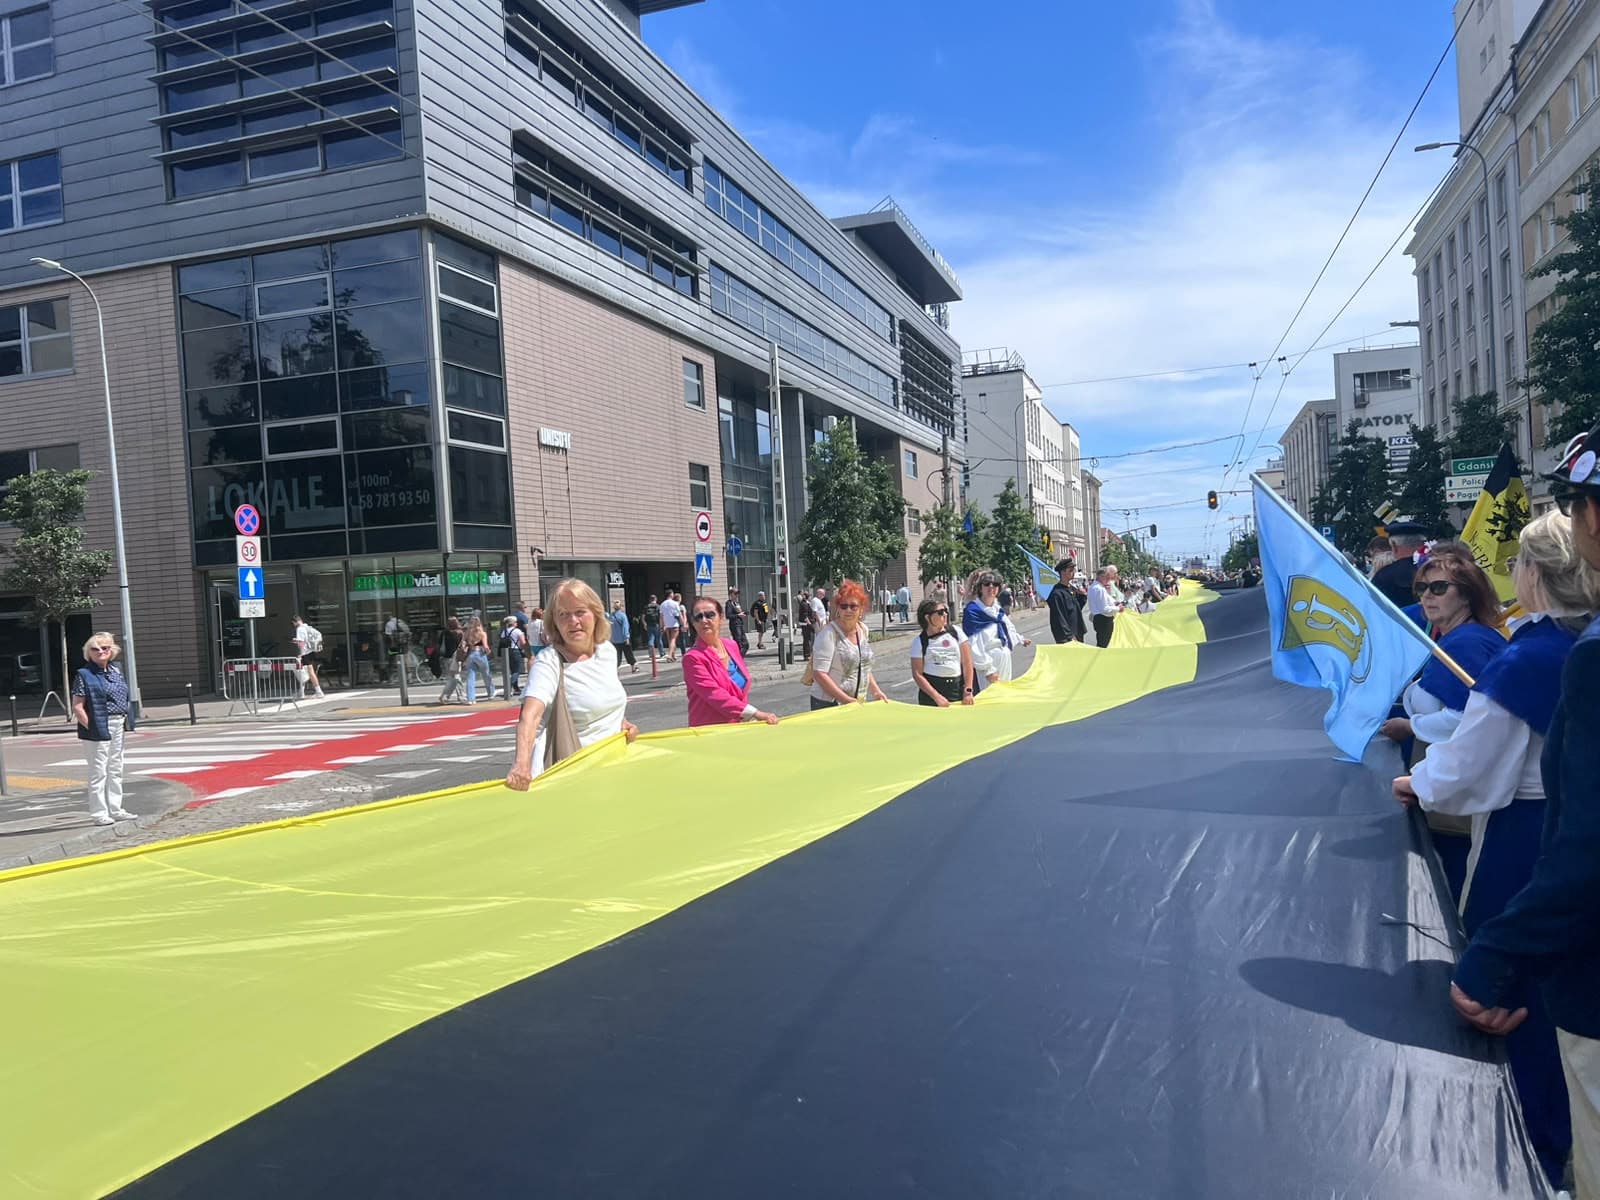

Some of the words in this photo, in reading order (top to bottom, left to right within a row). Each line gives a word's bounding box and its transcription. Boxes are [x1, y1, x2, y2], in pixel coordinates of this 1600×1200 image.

[1391, 436, 1414, 445] KFC
[208, 475, 326, 521] LOKALE
[244, 546, 255, 557] 30
